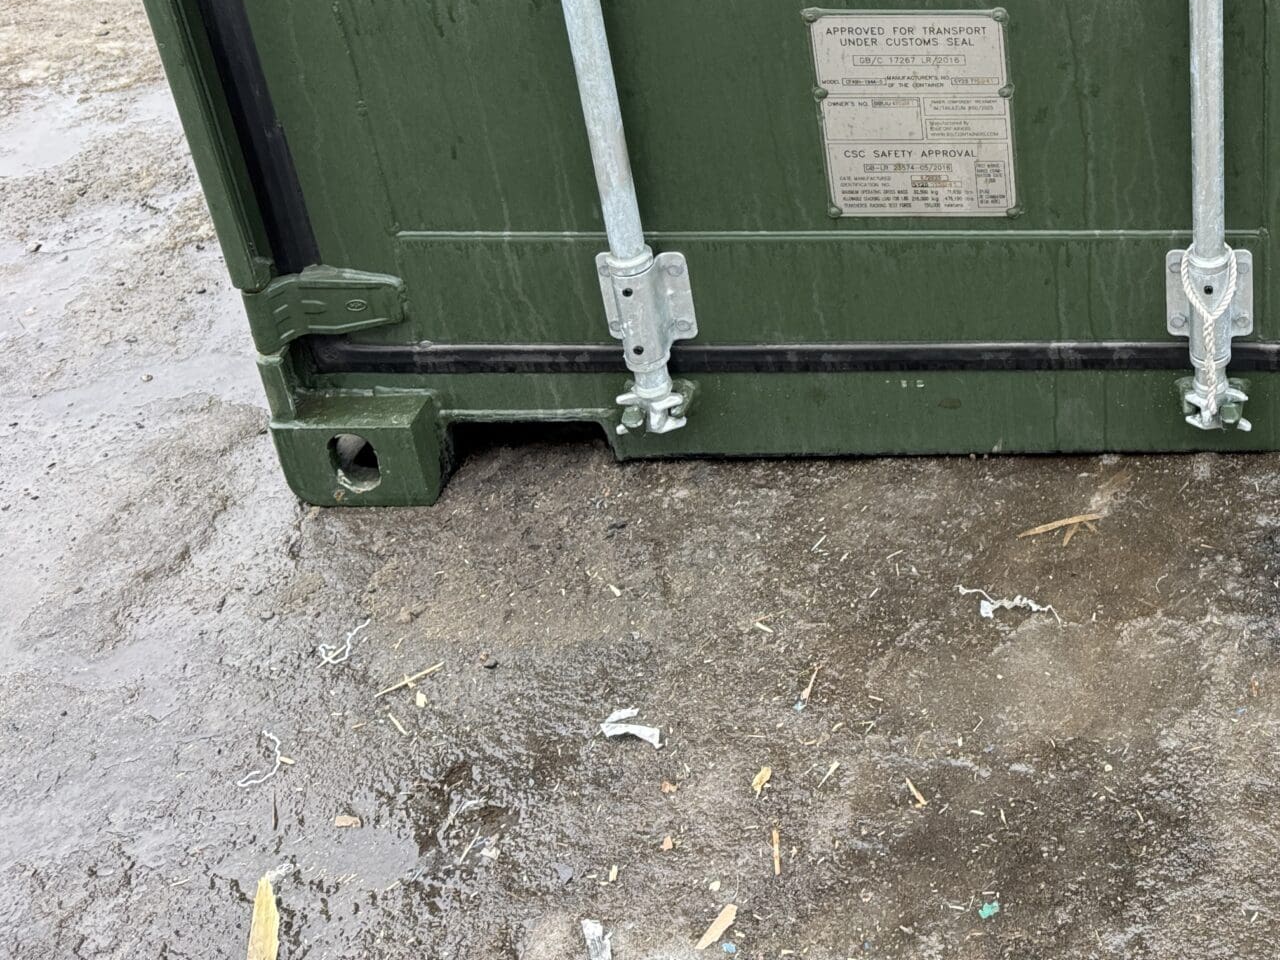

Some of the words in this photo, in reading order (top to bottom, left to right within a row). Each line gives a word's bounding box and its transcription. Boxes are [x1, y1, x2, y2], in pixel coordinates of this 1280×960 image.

[825, 26, 885, 36] APPROVED
[892, 26, 915, 36] FOR
[922, 26, 988, 36] TRANSPORT
[840, 38, 878, 47] UNDER
[885, 38, 939, 47] CUSTOMS
[945, 38, 975, 47] SEAL
[843, 149, 866, 158] CSC
[873, 149, 913, 158] SAFETY
[920, 149, 977, 158] APPROVAL
